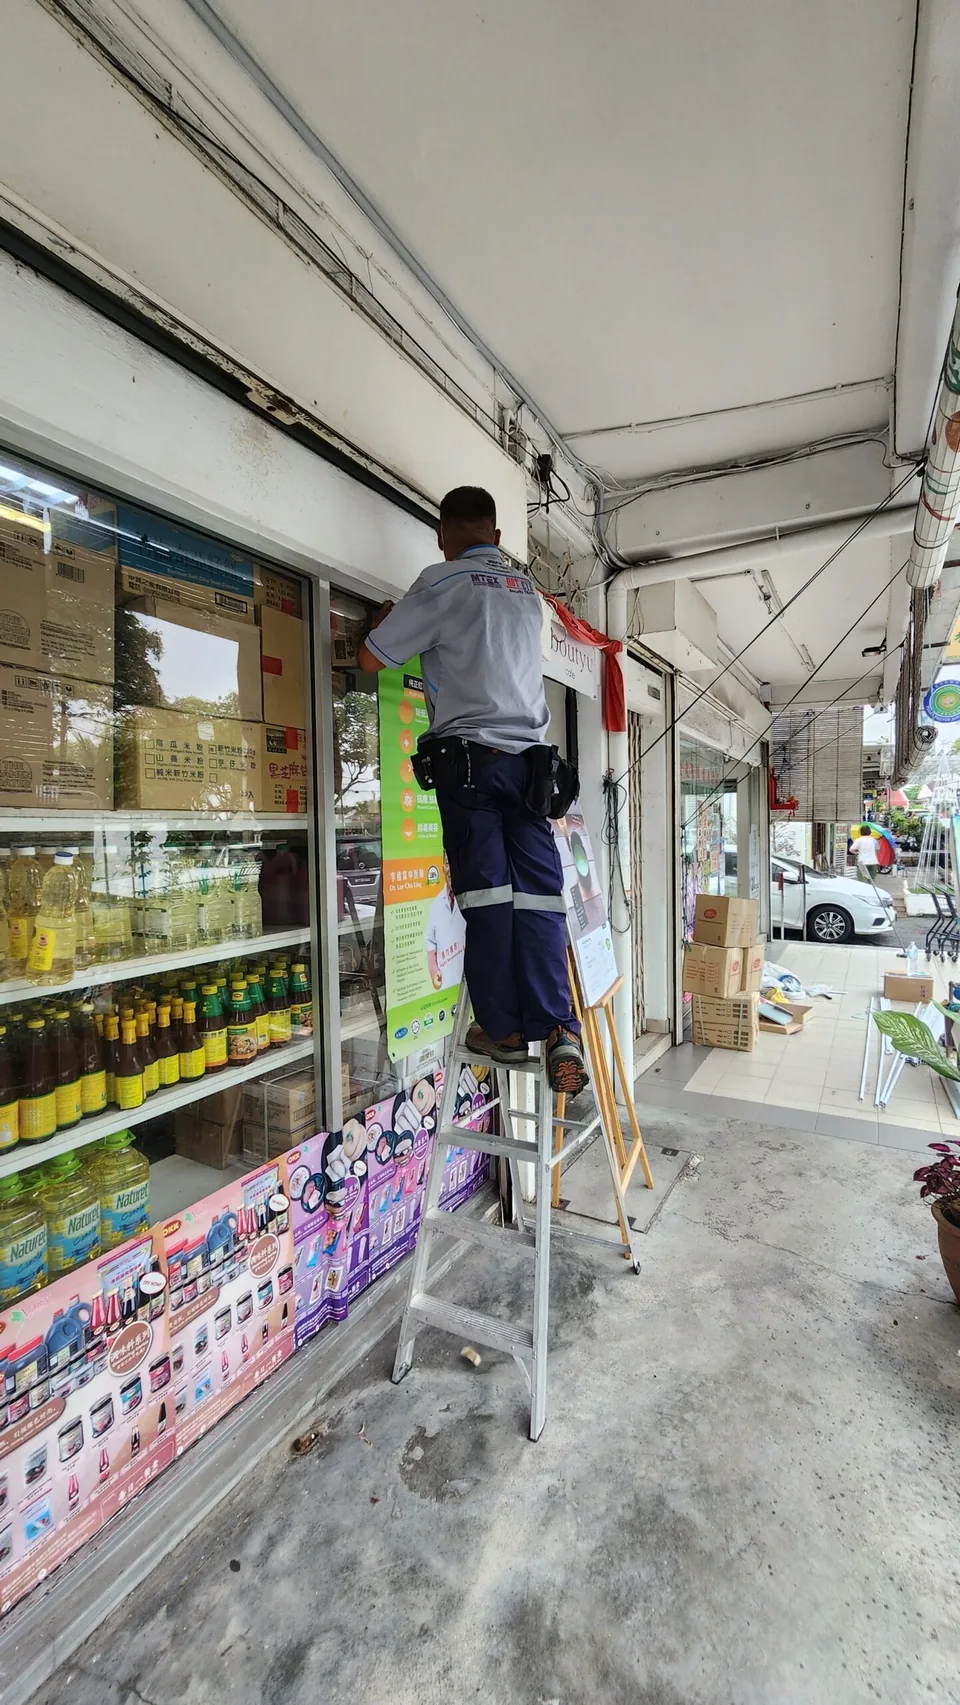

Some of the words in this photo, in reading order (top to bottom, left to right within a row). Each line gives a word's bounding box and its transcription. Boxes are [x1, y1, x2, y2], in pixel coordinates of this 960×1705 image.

[116, 1182, 149, 1210] Naturel
[67, 1203, 100, 1236] Naturel
[163, 1221, 180, 1236] OKK
[10, 1226, 47, 1262] Naturel
